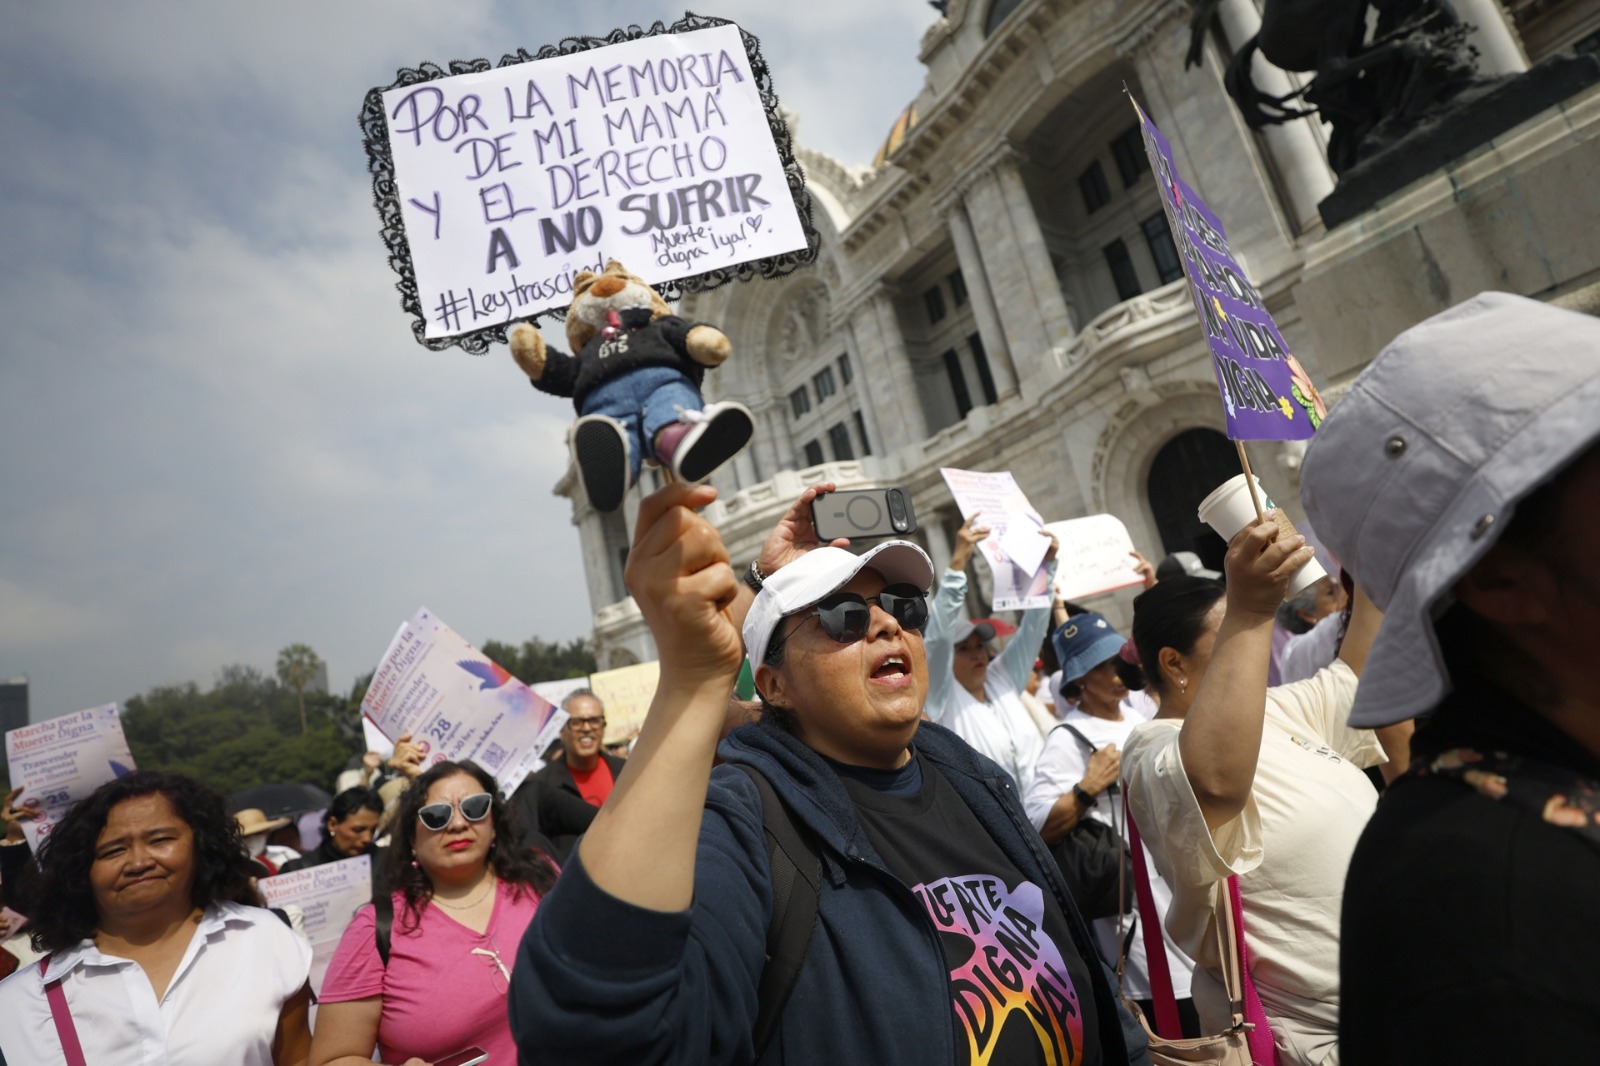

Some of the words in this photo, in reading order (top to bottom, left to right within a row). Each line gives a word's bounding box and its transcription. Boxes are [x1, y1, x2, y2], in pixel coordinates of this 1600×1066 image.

[392, 86, 489, 147] POR
[505, 79, 554, 123] LA
[567, 49, 745, 110] MEMORIA
[454, 132, 523, 180] DE
[533, 118, 584, 165] MI
[603, 85, 728, 146] MAMÁ
[408, 190, 441, 240] Y
[479, 182, 537, 224] EL
[546, 135, 727, 210] DERECHO
[487, 227, 521, 274] A
[540, 206, 603, 256] NO
[618, 174, 771, 236] SUFRIR
[651, 225, 708, 254] Muerte
[657, 247, 709, 270] digna
[599, 339, 629, 360] BTS
[1224, 312, 1288, 361] VIDA
[1213, 349, 1284, 413] DIGNA
[365, 663, 392, 706] Marcha
[390, 641, 405, 667] por
[401, 630, 415, 643] la
[372, 673, 397, 713] Muerte
[395, 639, 422, 673] Digna
[390, 672, 427, 723] Trascender
[12, 720, 56, 741] Marcha
[58, 714, 78, 729] por
[81, 711, 93, 721] la
[12, 733, 55, 751] Muerte
[58, 722, 94, 739] Digna
[430, 719, 451, 741] 28
[22, 750, 78, 771] Trascender
[265, 870, 313, 890] Marcha
[314, 866, 335, 880] por
[337, 861, 348, 871] la
[265, 882, 312, 900] Muerte
[313, 874, 348, 889] Digna
[950, 906, 1041, 1058] DIGNA
